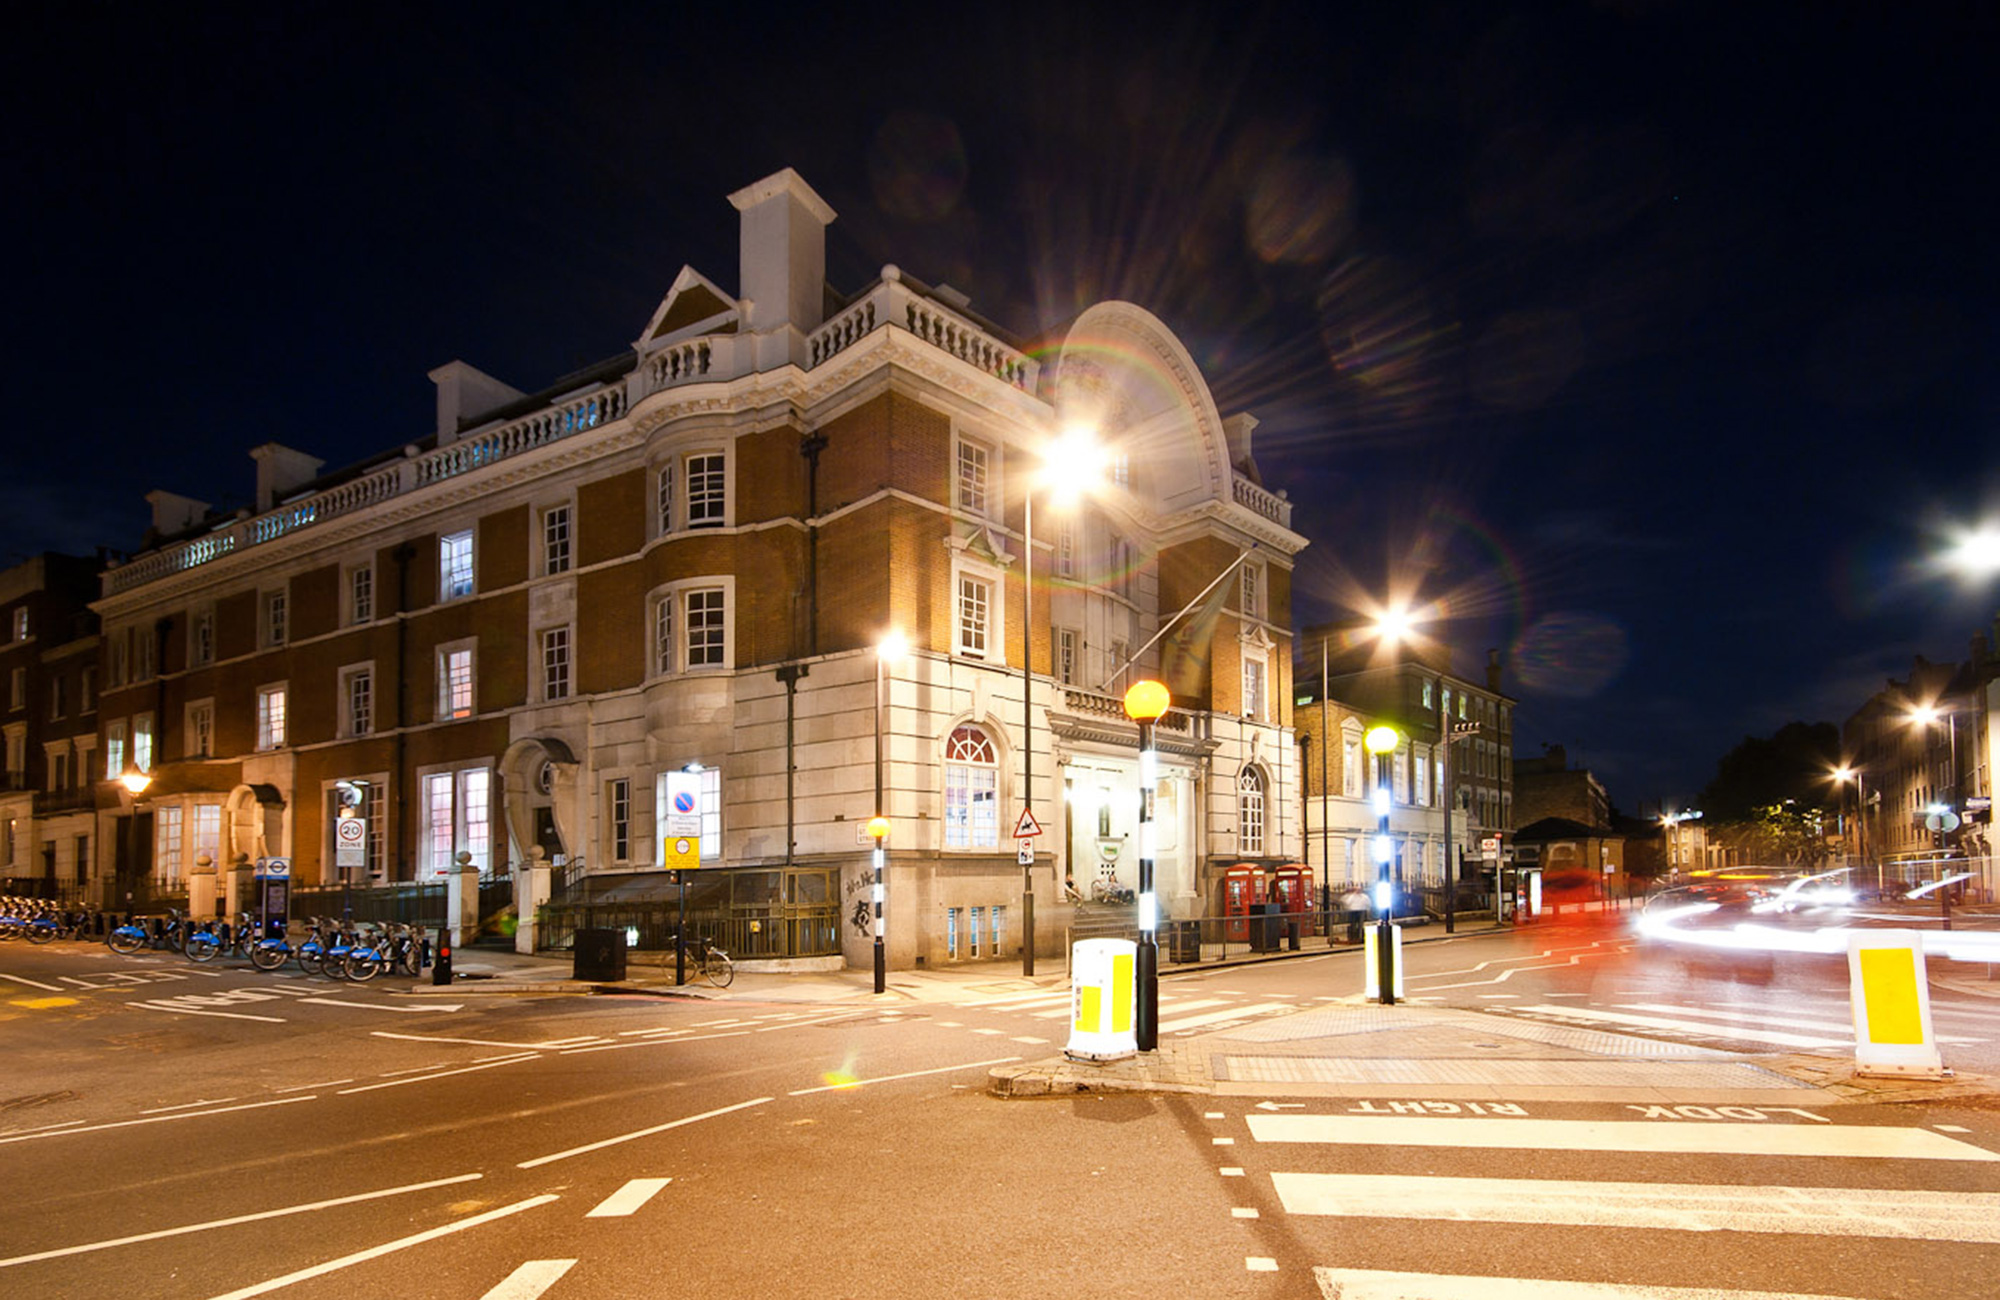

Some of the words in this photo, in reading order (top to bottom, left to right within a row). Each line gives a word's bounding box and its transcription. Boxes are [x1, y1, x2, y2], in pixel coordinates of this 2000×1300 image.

[343, 825, 360, 835] 20
[1348, 1100, 1530, 1116] RIGHT
[1625, 1104, 1832, 1122] LOOK
